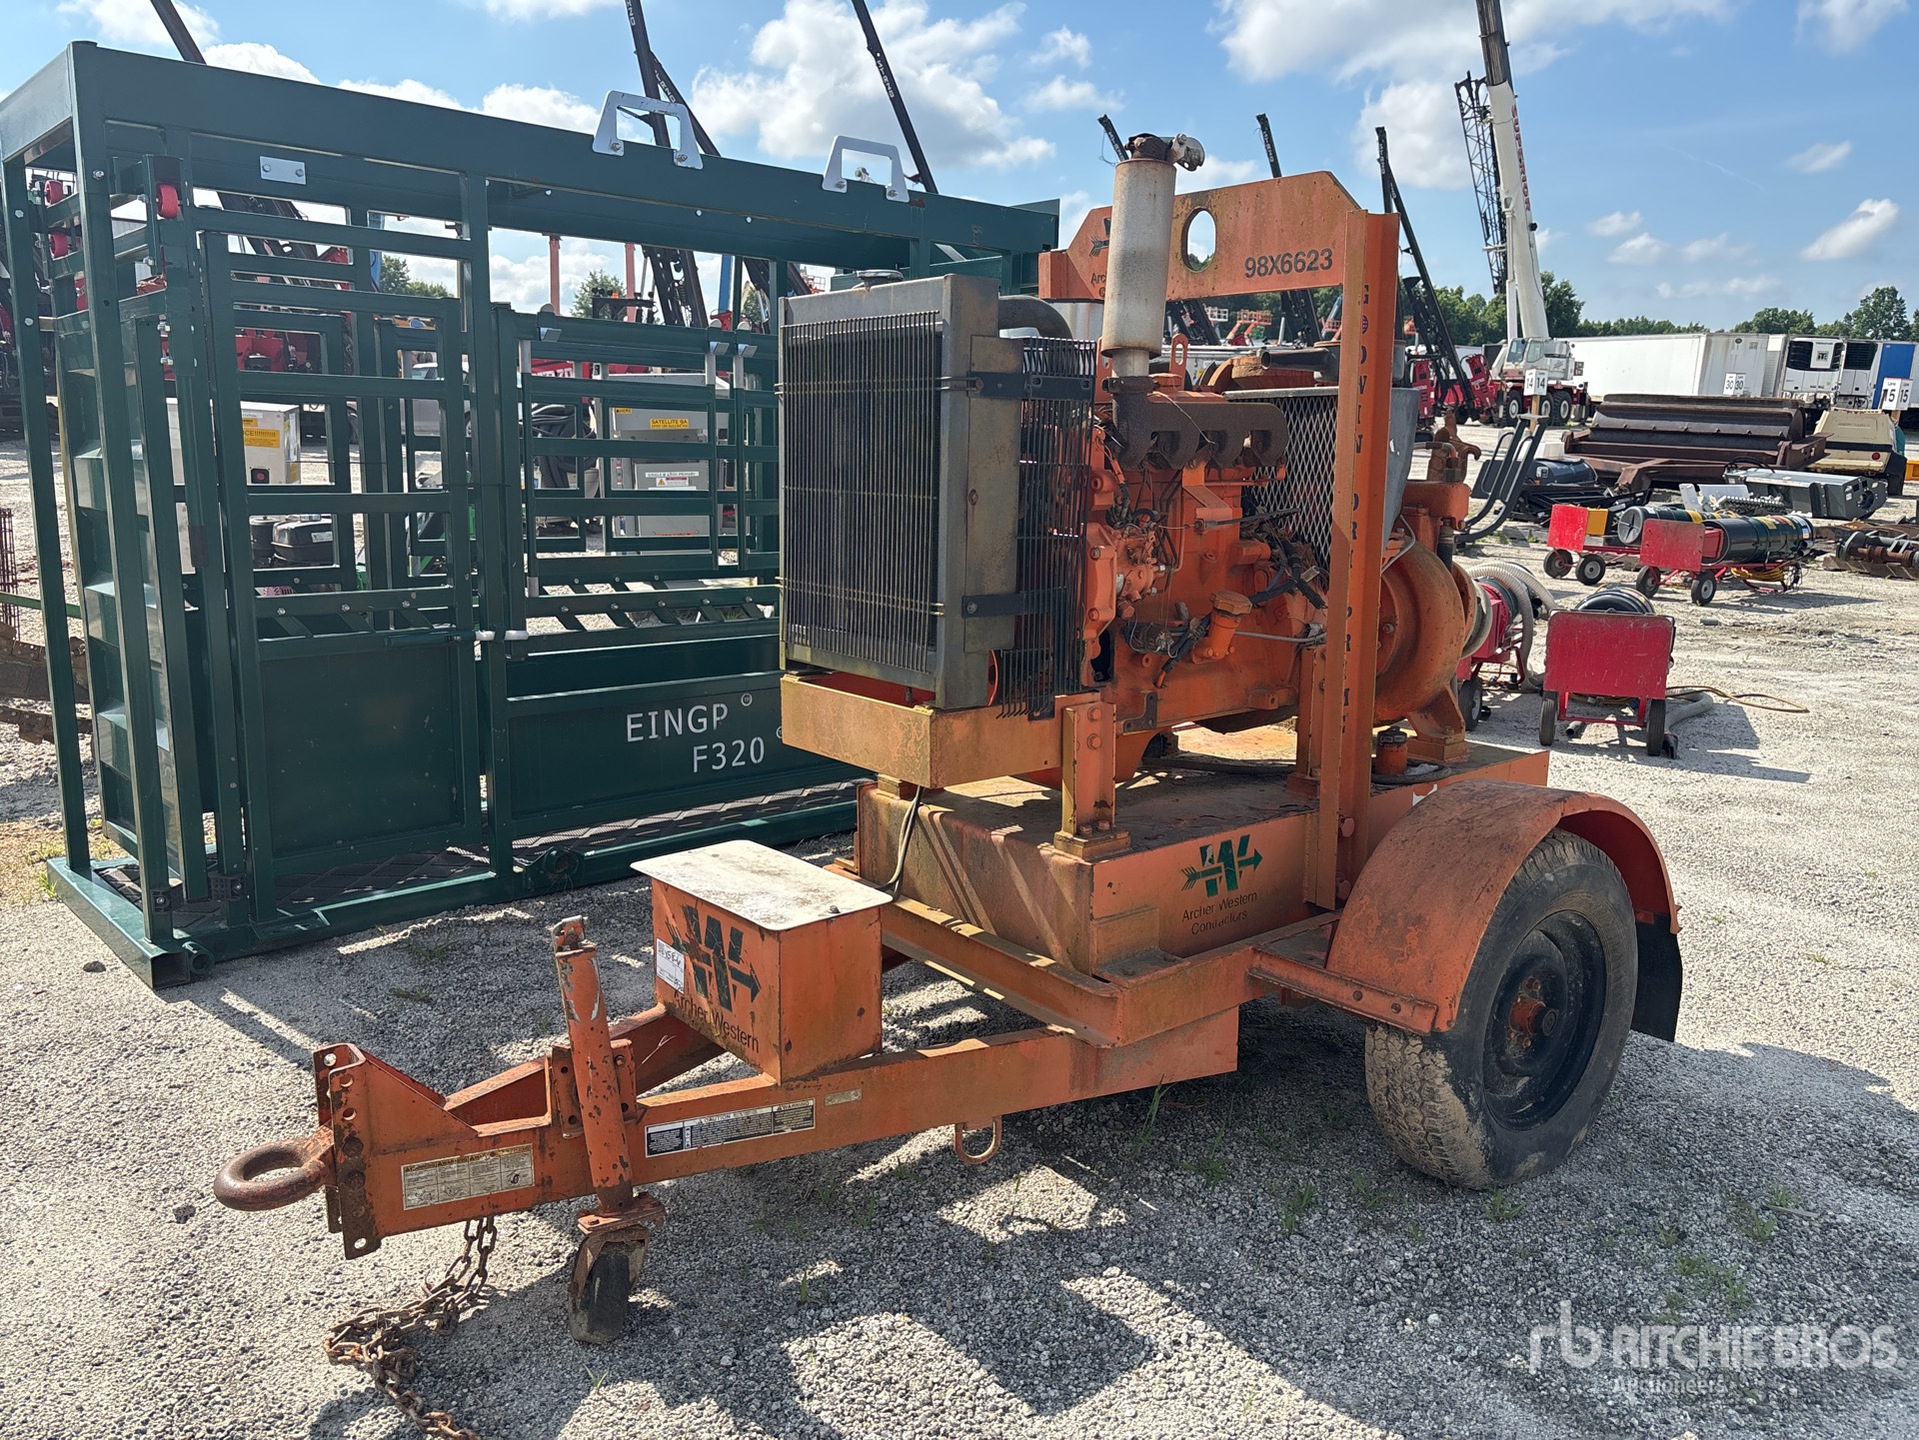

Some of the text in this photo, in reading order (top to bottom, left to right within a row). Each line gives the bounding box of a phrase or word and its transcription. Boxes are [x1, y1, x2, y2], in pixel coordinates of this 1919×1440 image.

[1511, 104, 1531, 211] SUPERIOR
[1244, 247, 1333, 278] 98X6623
[1526, 377, 1534, 390] 14
[1536, 377, 1546, 389] 14
[1725, 380, 1734, 390] 30
[1734, 380, 1744, 391] 30
[1900, 389, 1909, 403] 15
[626, 703, 728, 742] EINGP
[693, 736, 765, 773] F320
[1182, 891, 1258, 922] Archer Western
[711, 1007, 759, 1053] Western
